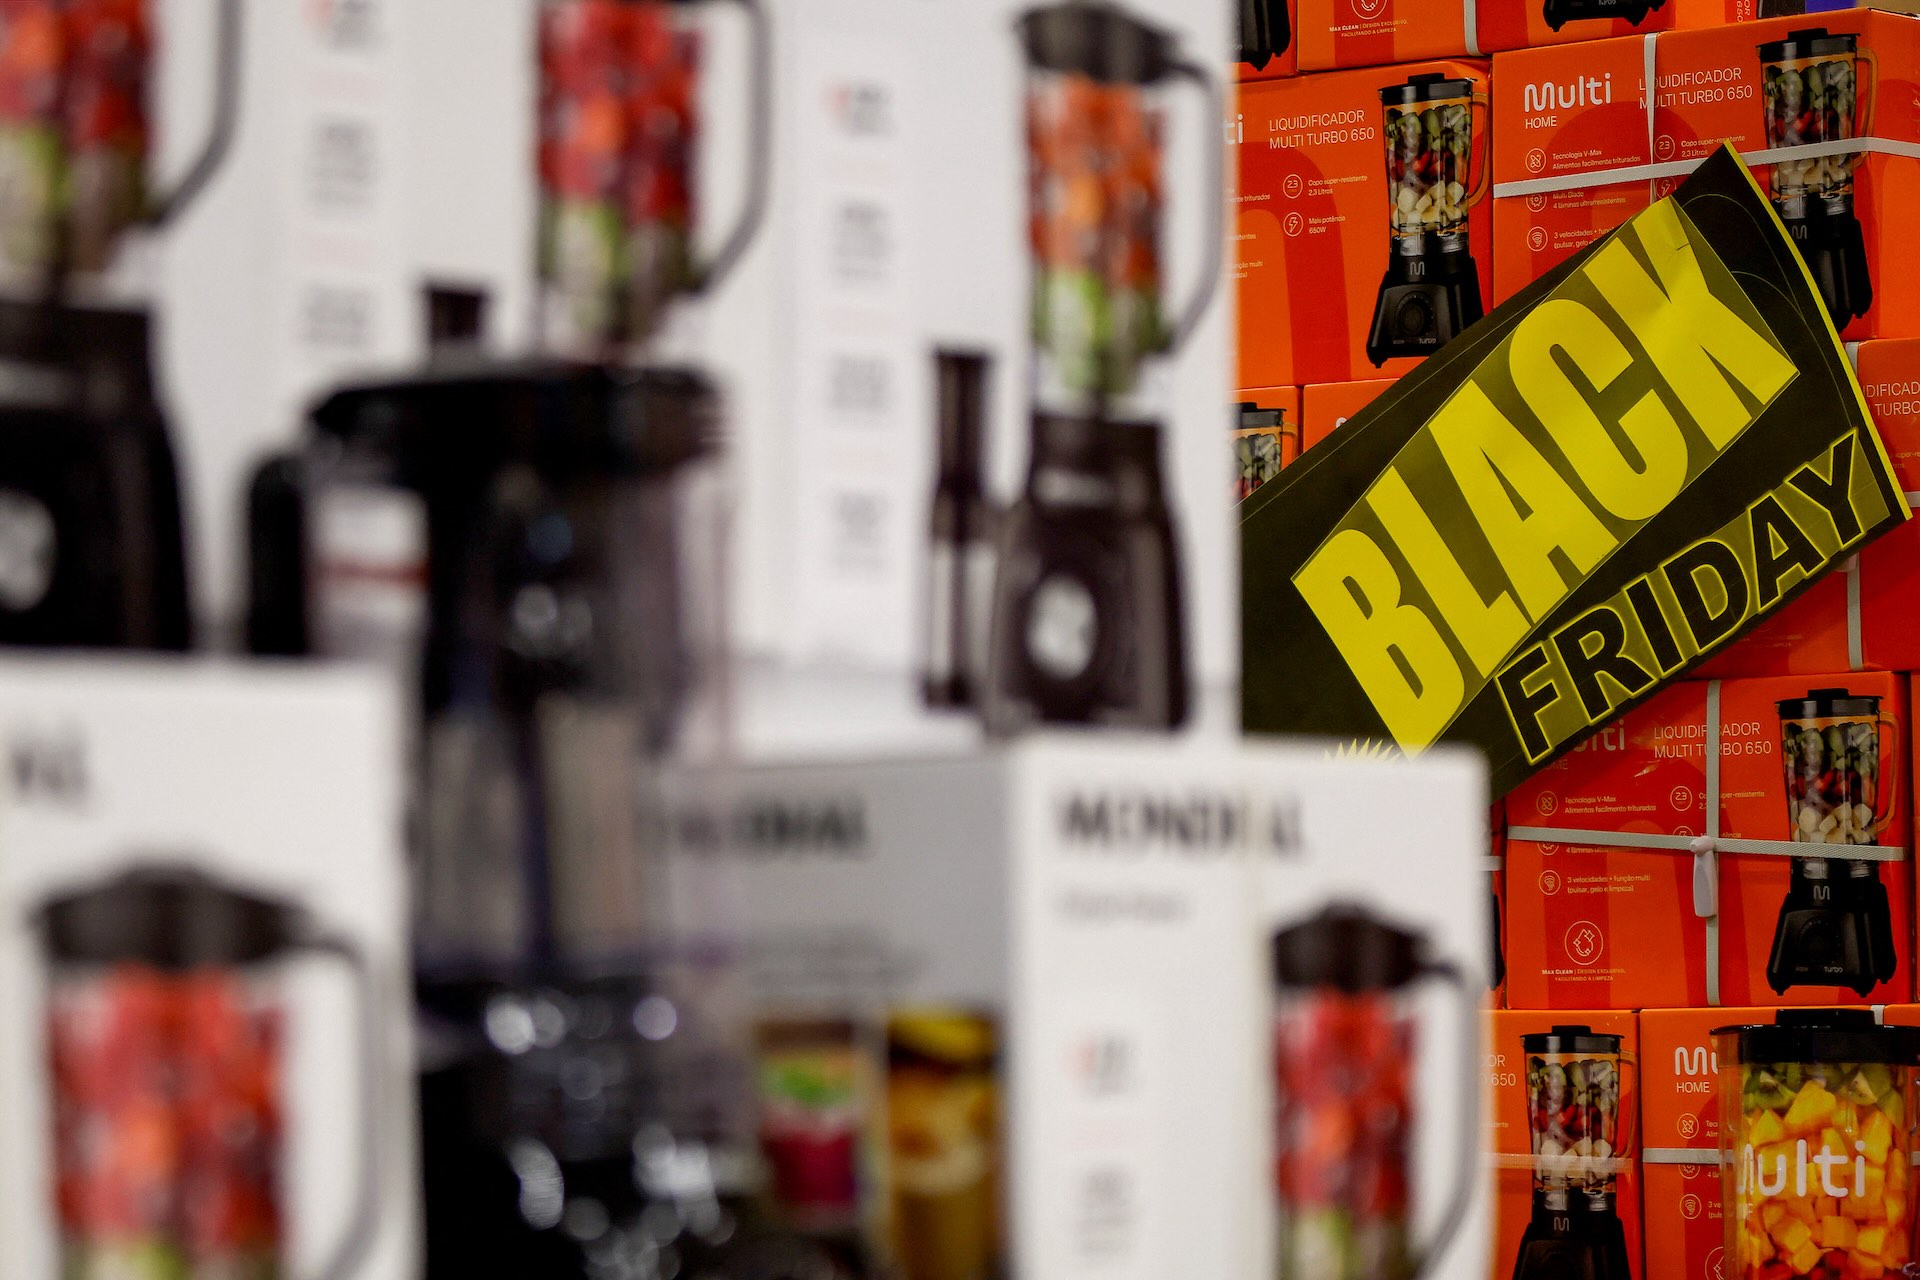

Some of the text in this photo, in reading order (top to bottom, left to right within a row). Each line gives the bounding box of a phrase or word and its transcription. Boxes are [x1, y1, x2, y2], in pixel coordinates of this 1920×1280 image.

[1524, 72, 1612, 113] Multi
[1679, 88, 1724, 105] TURBO
[1727, 85, 1752, 100] 650
[1269, 110, 1365, 132] LIQUIDIFICADOR
[1525, 116, 1557, 129] HOME
[1269, 127, 1374, 149] MULTI TURBO 650
[1681, 140, 1697, 148] Copo
[1553, 152, 1582, 160] Tecnologia
[1553, 156, 1641, 170] Alimentos facilmente triturados
[1308, 179, 1323, 187] Copo
[1296, 195, 1797, 759] BLACK
[1496, 428, 1865, 765] FRIDAY
[1654, 744, 1692, 758] MULTI
[1745, 740, 1772, 755] 650
[1491, 1073, 1516, 1087] 650
[1676, 1082, 1710, 1093] HOME
